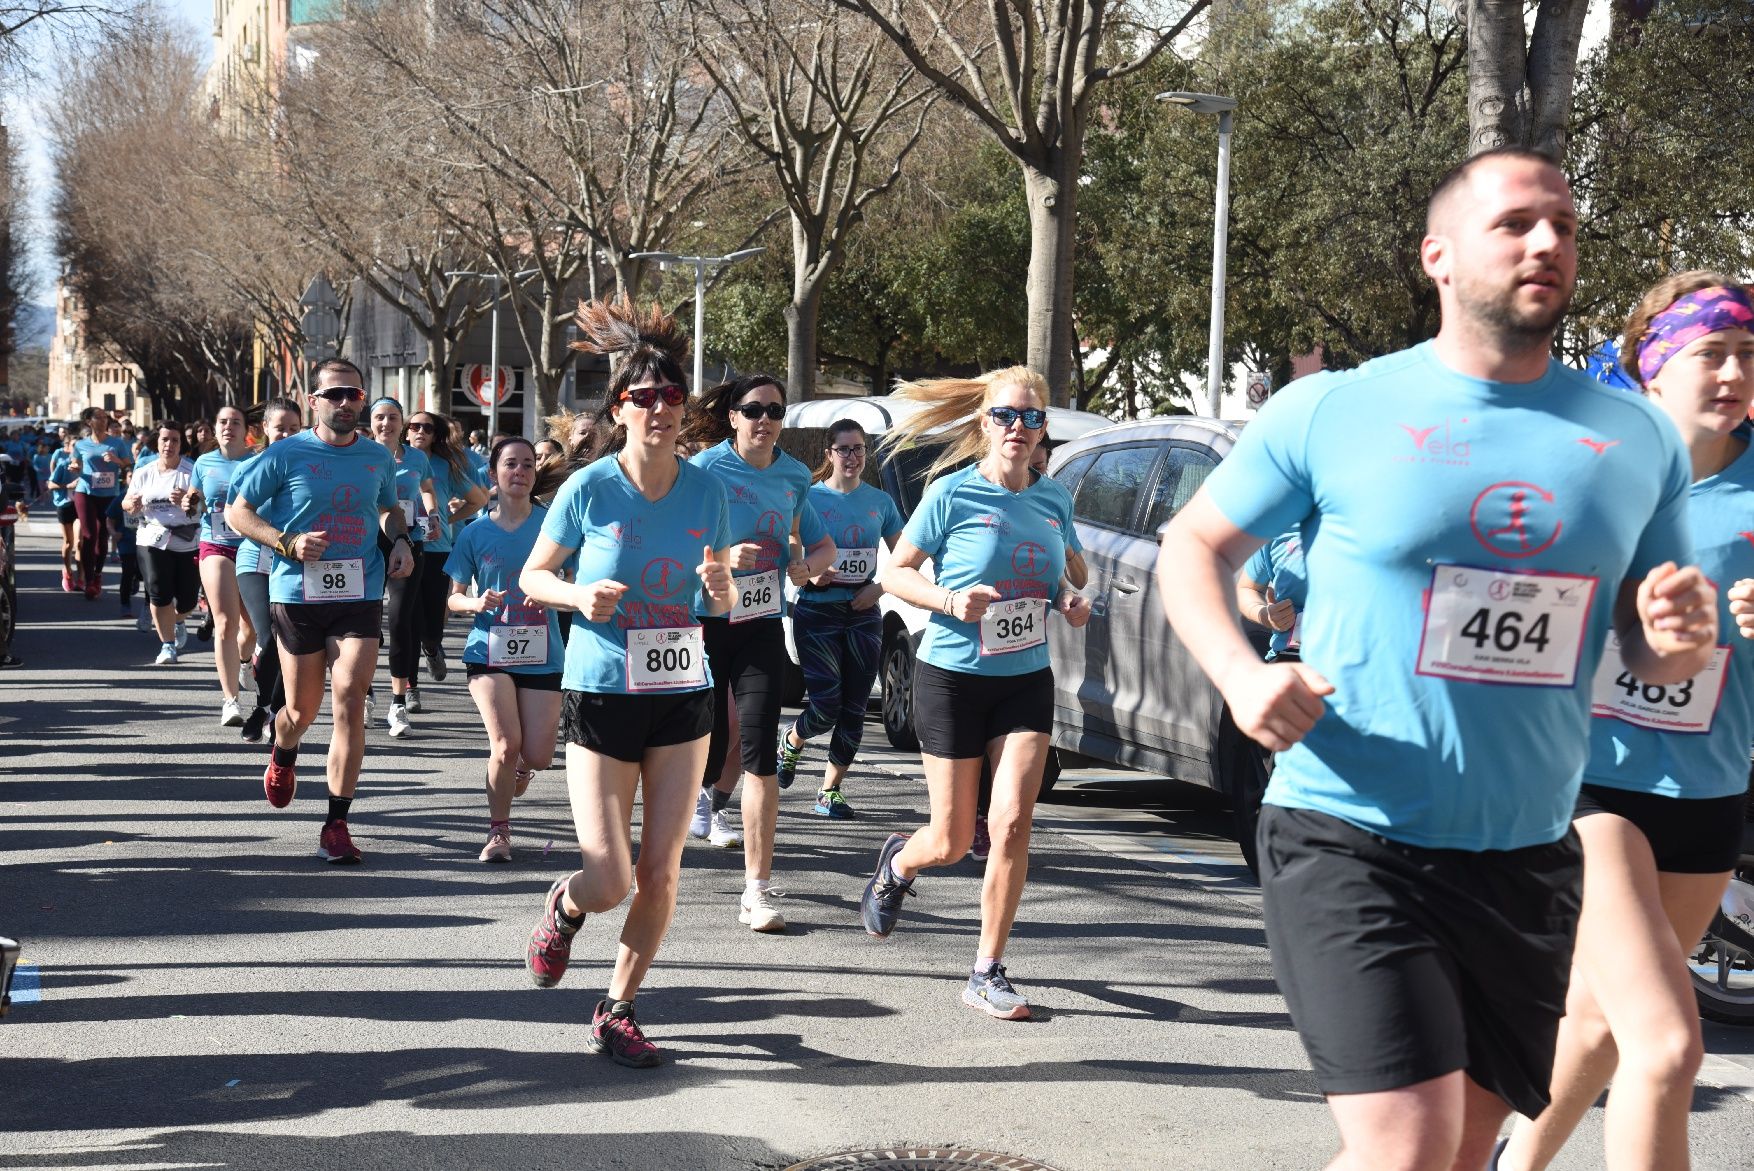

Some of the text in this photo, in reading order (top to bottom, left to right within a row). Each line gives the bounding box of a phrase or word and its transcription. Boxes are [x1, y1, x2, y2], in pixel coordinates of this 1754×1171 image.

[839, 559, 867, 574] 450
[323, 573, 346, 589] 98
[742, 587, 772, 608] 646
[996, 612, 1034, 639] 364
[1460, 607, 1551, 653] 464
[507, 639, 530, 656] 97
[646, 647, 691, 673] 800
[1615, 670, 1694, 707] 463
